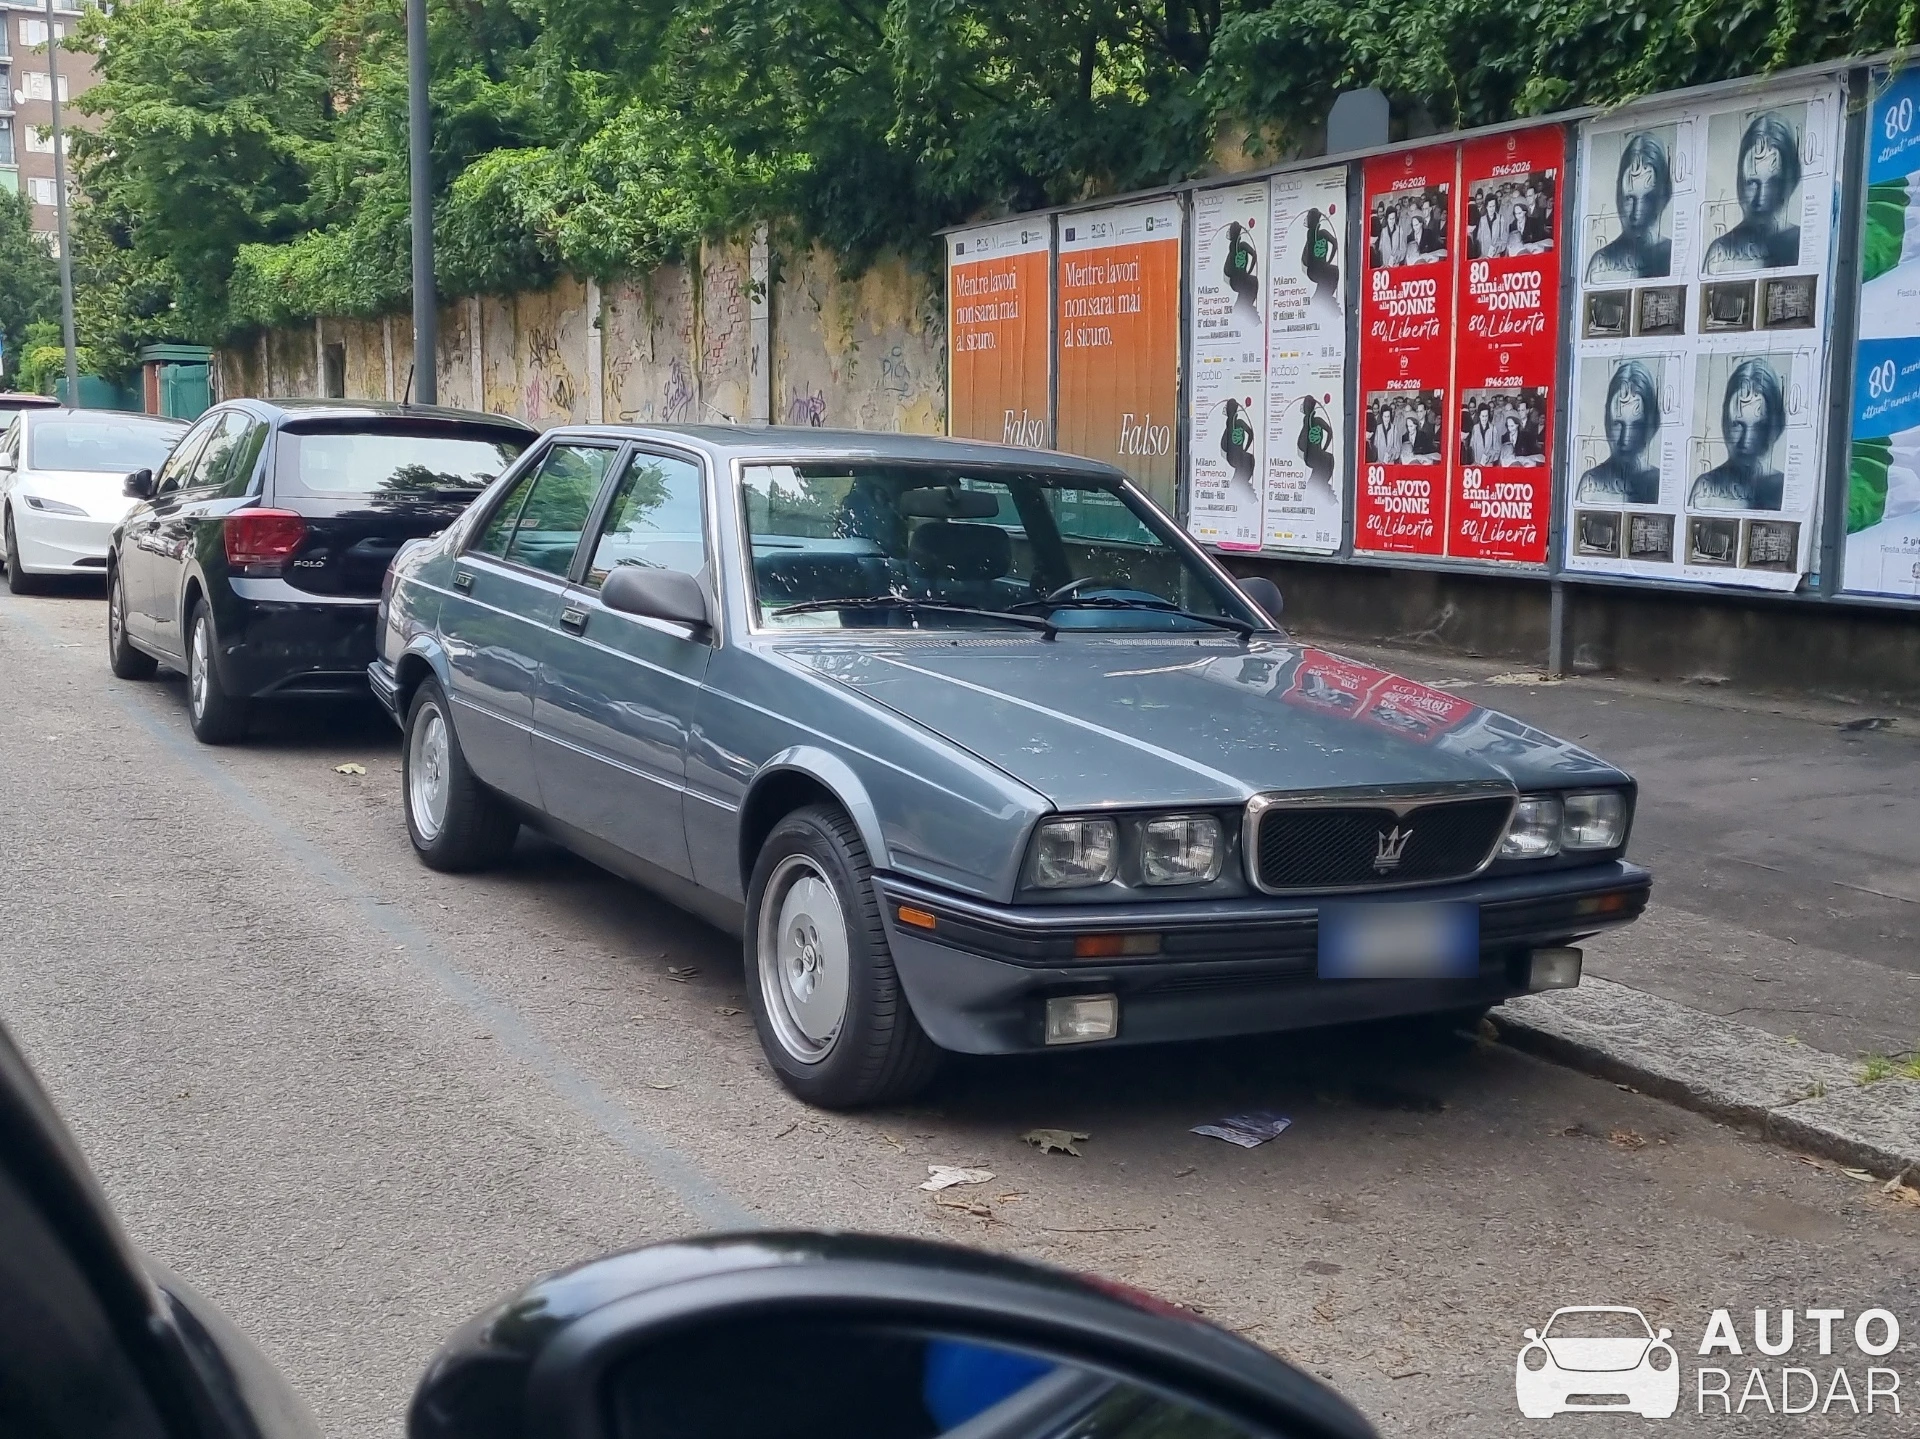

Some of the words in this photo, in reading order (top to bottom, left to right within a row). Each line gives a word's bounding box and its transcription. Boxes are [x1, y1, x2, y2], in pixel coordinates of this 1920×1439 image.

[1885, 97, 1912, 139] 80
[1492, 161, 1531, 177] 1946-2026
[1392, 176, 1426, 191] 1946-2026
[1064, 262, 1104, 288] Mentre
[1106, 254, 1139, 284] lavori
[1274, 276, 1297, 285] Milano
[1373, 270, 1390, 291] 80
[1470, 261, 1489, 283] 80
[956, 274, 988, 297] Mentre
[990, 266, 1017, 292] lavori
[1198, 286, 1219, 294] Milano
[1372, 285, 1397, 301] anni
[1401, 279, 1436, 298] VOTO
[1470, 276, 1497, 294] anni
[1502, 270, 1541, 290] VOTO
[1198, 297, 1230, 305] Flamenco
[1274, 288, 1307, 296] Flamenco
[1478, 294, 1489, 304] alle
[1488, 290, 1540, 310] DONNE
[956, 305, 974, 325] non
[974, 297, 998, 322] sarai
[1000, 295, 1018, 319] mai
[1064, 298, 1087, 318] non
[1088, 289, 1115, 316] sarai
[1118, 287, 1141, 314] mai
[1198, 306, 1222, 316] Festival
[1274, 297, 1301, 307] Festival
[1389, 297, 1436, 317] DONNE
[1372, 320, 1386, 336] 80
[1388, 316, 1440, 342] Libertà
[1468, 314, 1485, 331] 80
[1488, 310, 1545, 338] Libertà
[956, 328, 964, 352] al
[966, 328, 996, 350] sicuro.
[1064, 322, 1074, 348] al
[1076, 322, 1113, 347] sicuro.
[1386, 380, 1421, 389] 1946-2026
[1484, 376, 1524, 387] 1946-2026
[1869, 360, 1895, 398] 80
[1002, 408, 1044, 448] Falso
[1118, 413, 1170, 456] Falso
[1196, 458, 1216, 466] Milano
[1270, 458, 1292, 466] Milano
[1196, 468, 1226, 477] Flamenco
[1270, 469, 1304, 478] Flamenco
[1368, 466, 1384, 485] 80
[1463, 468, 1482, 488] 80
[1196, 479, 1220, 487] Festival
[1269, 480, 1296, 489] Festival
[1368, 482, 1392, 495] anni
[1396, 480, 1430, 497] VOTO
[1463, 485, 1490, 499] anni
[1495, 483, 1533, 501] VOTO
[1384, 497, 1430, 514] DONNE
[1481, 500, 1532, 519] DONNE
[1366, 514, 1381, 529] 80
[1384, 514, 1433, 540] Libertà
[1461, 520, 1478, 535] 80
[1480, 520, 1536, 546] Libertà
[1903, 536, 1908, 544] 2
[294, 560, 324, 568] POLO
